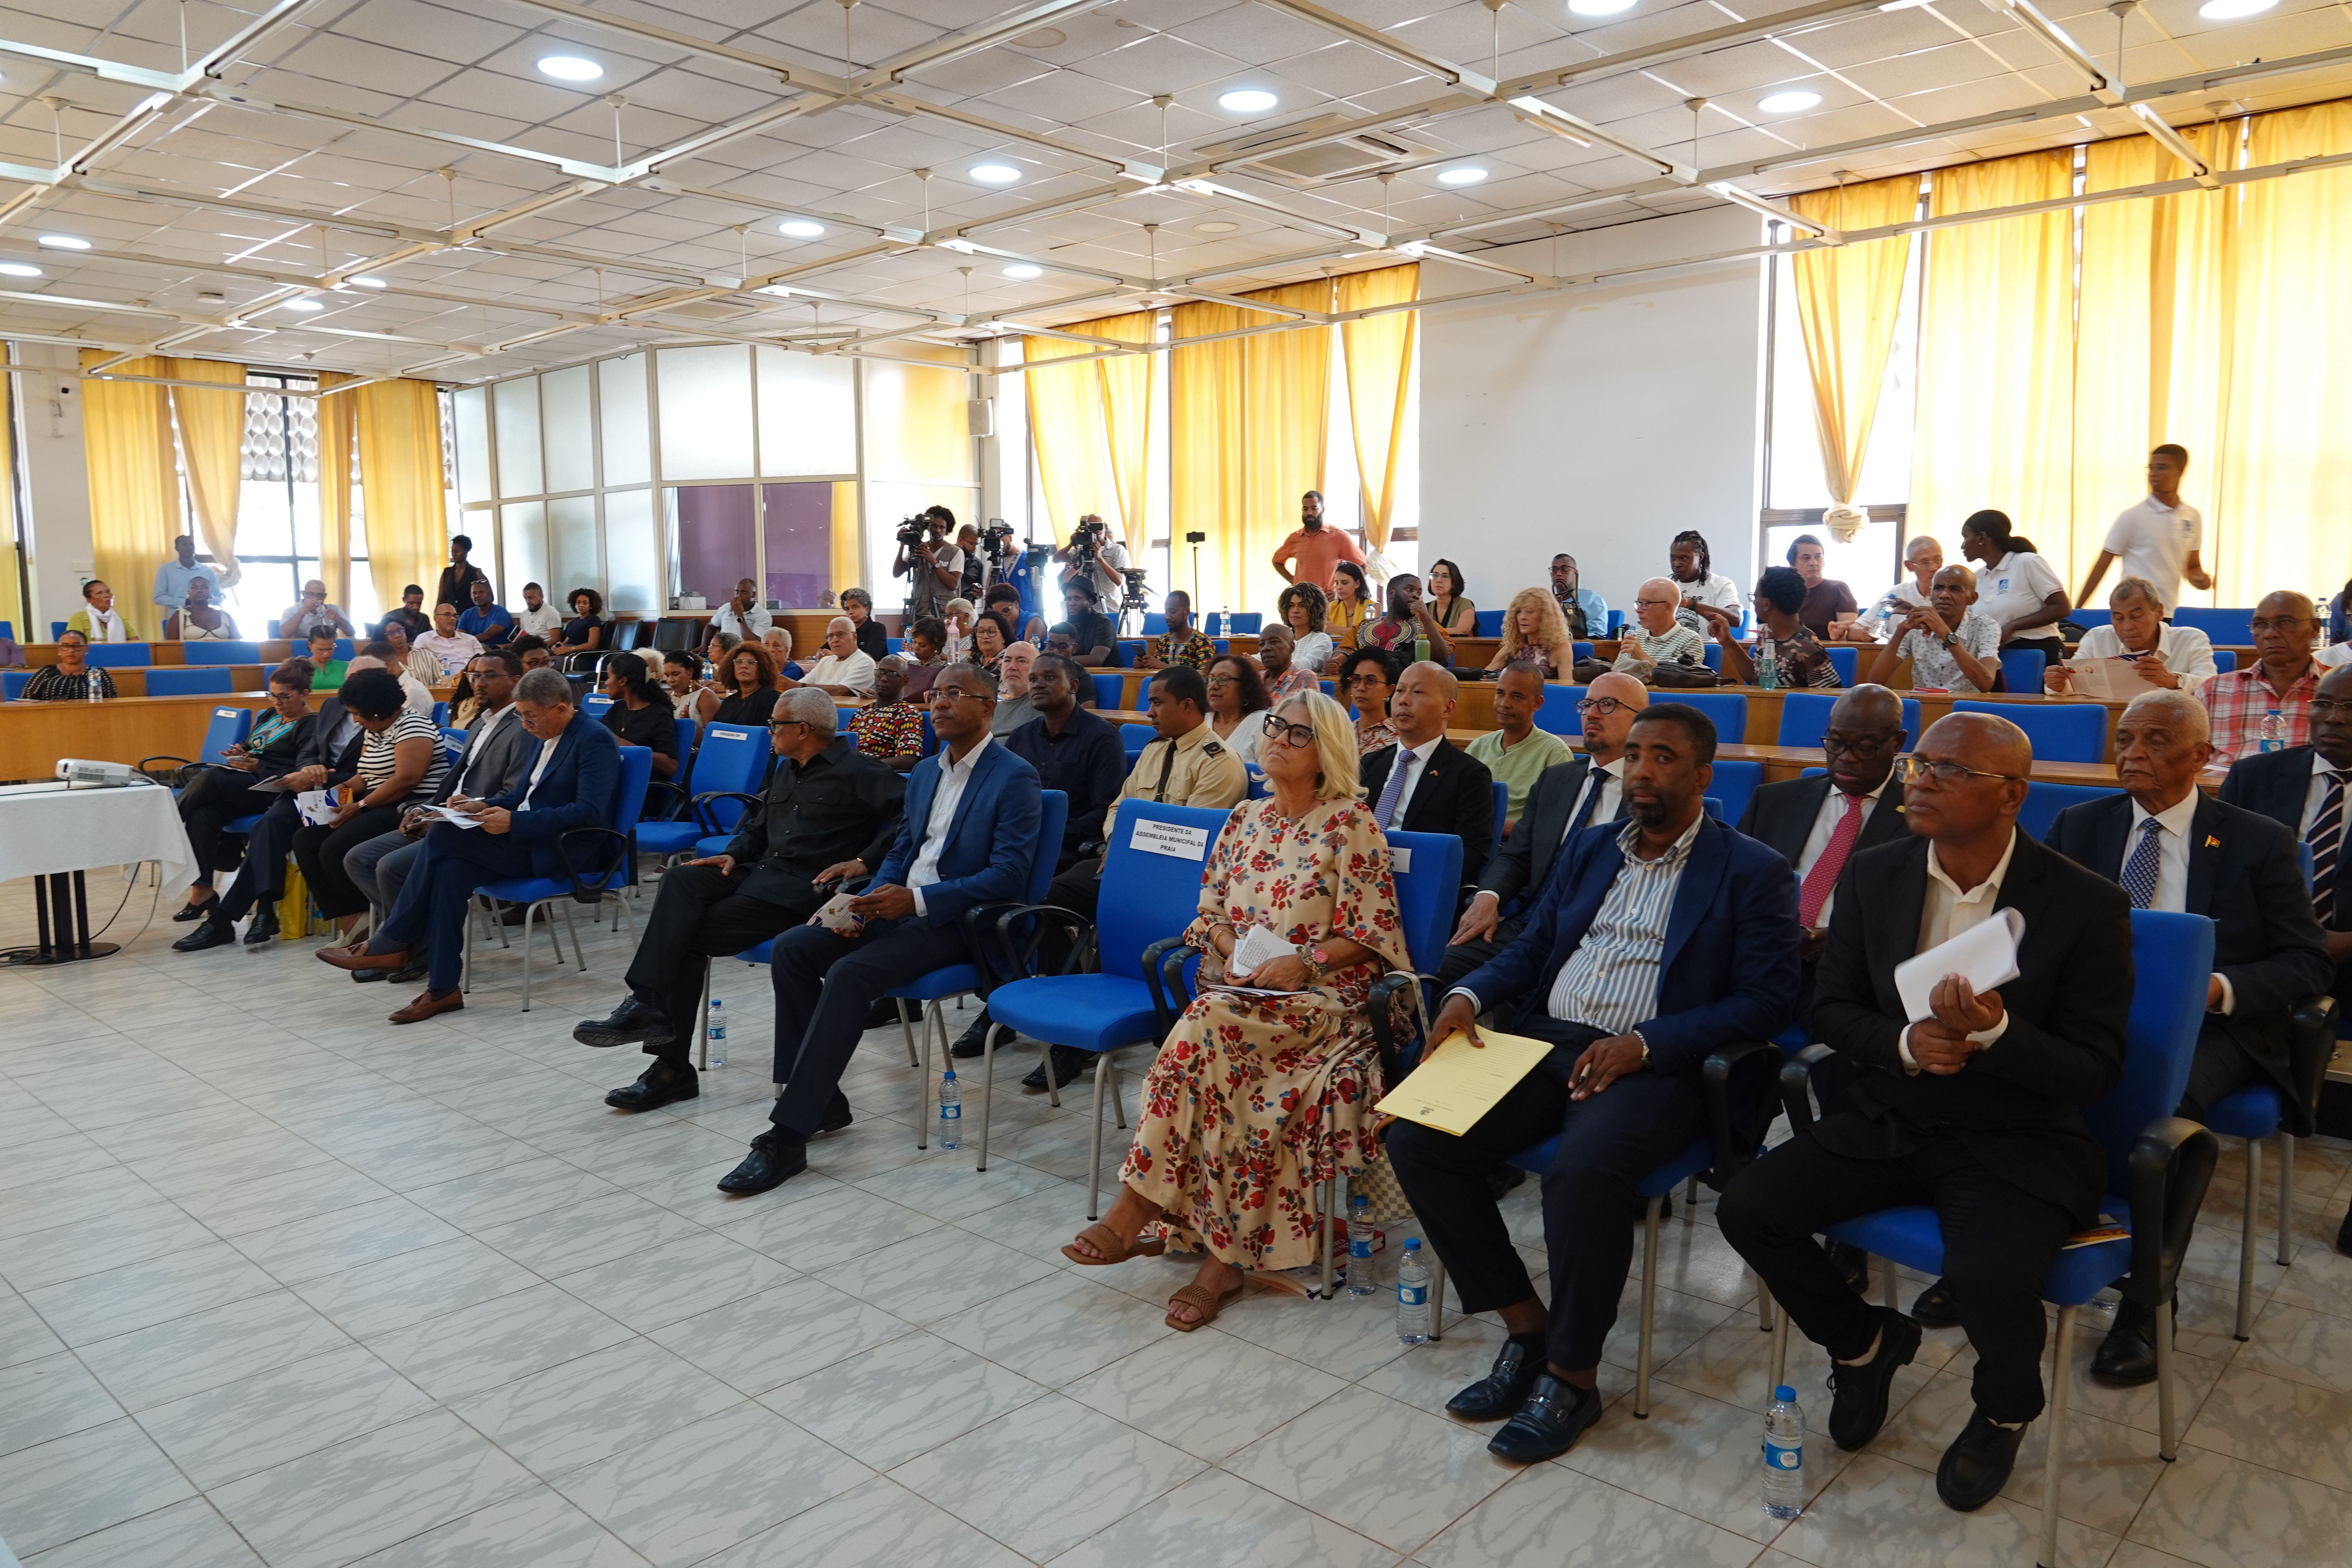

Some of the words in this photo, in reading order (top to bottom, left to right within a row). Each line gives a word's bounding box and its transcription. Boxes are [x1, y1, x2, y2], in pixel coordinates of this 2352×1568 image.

[1152, 824, 1185, 834] PRESIDENTE
[1135, 831, 1167, 841] ASSEMBLEIA
[1169, 836, 1196, 846] MUNICIPAL
